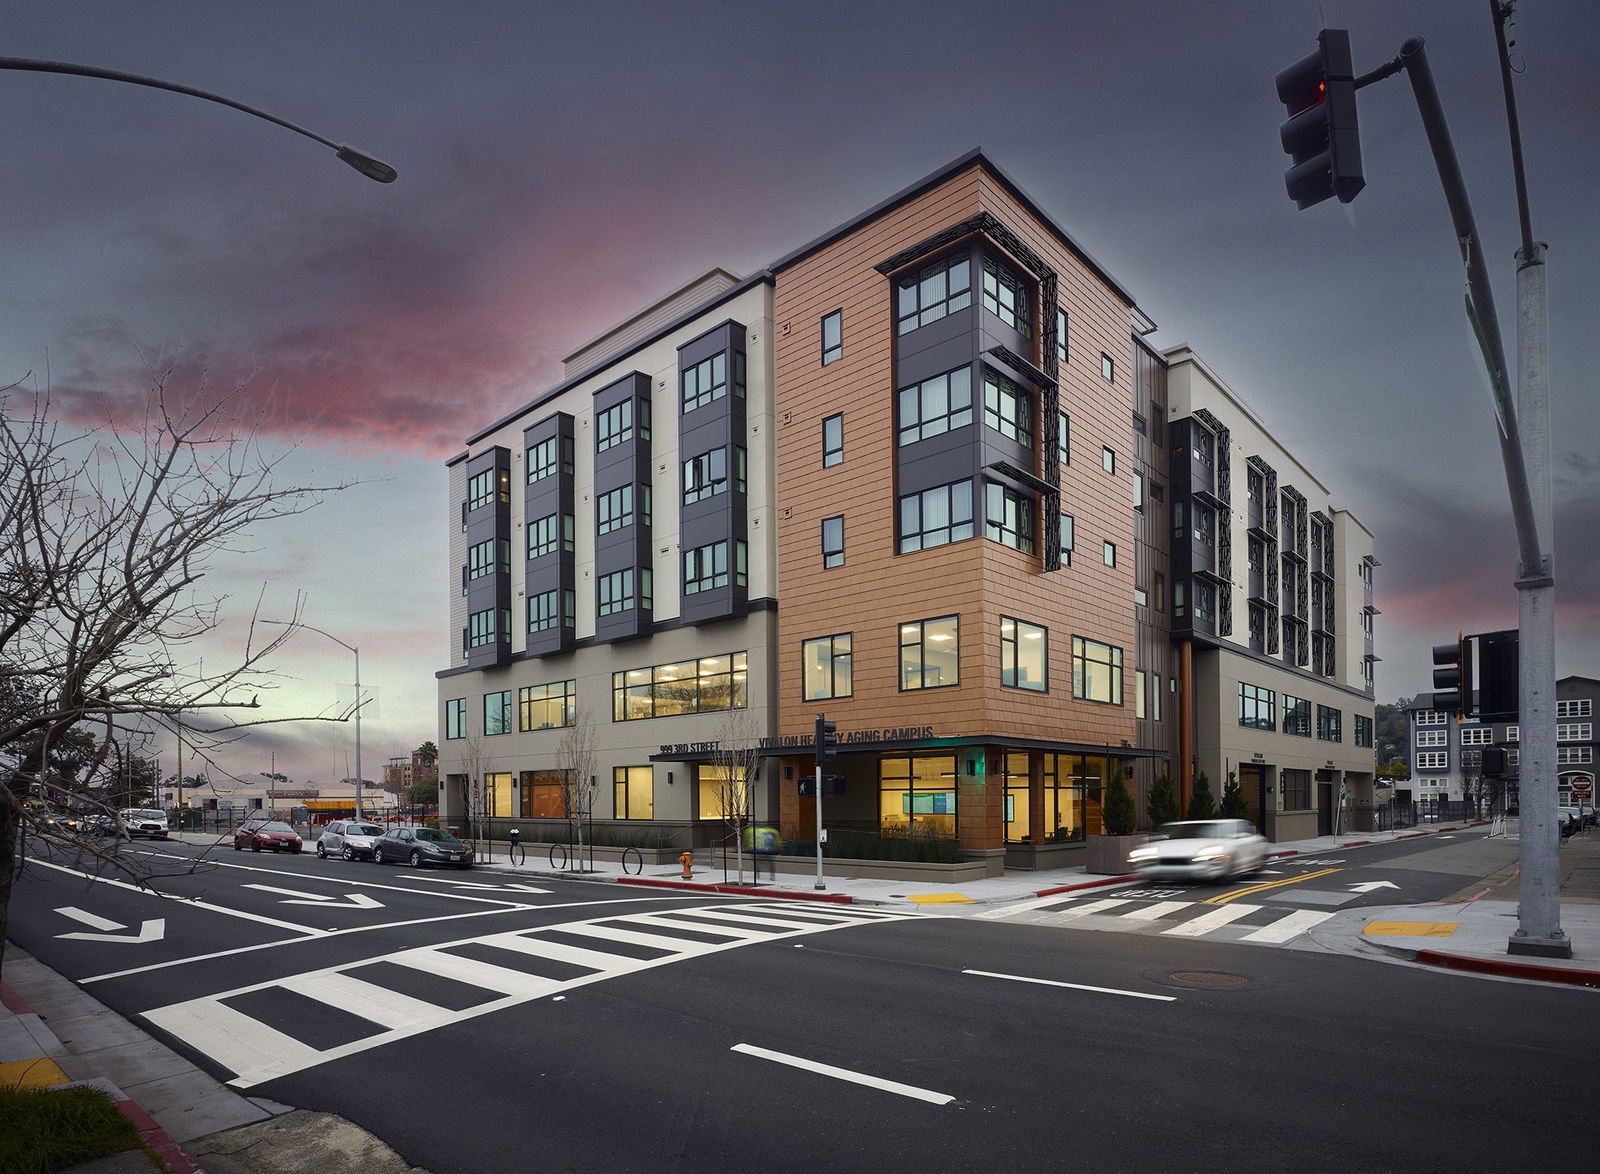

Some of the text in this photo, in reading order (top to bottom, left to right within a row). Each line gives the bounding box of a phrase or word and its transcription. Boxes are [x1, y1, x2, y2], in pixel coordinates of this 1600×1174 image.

[759, 735, 799, 747] VIVALON
[847, 729, 880, 743] AGING
[882, 725, 933, 742] CAMPUS
[660, 740, 720, 754] 999 3RD STREET
